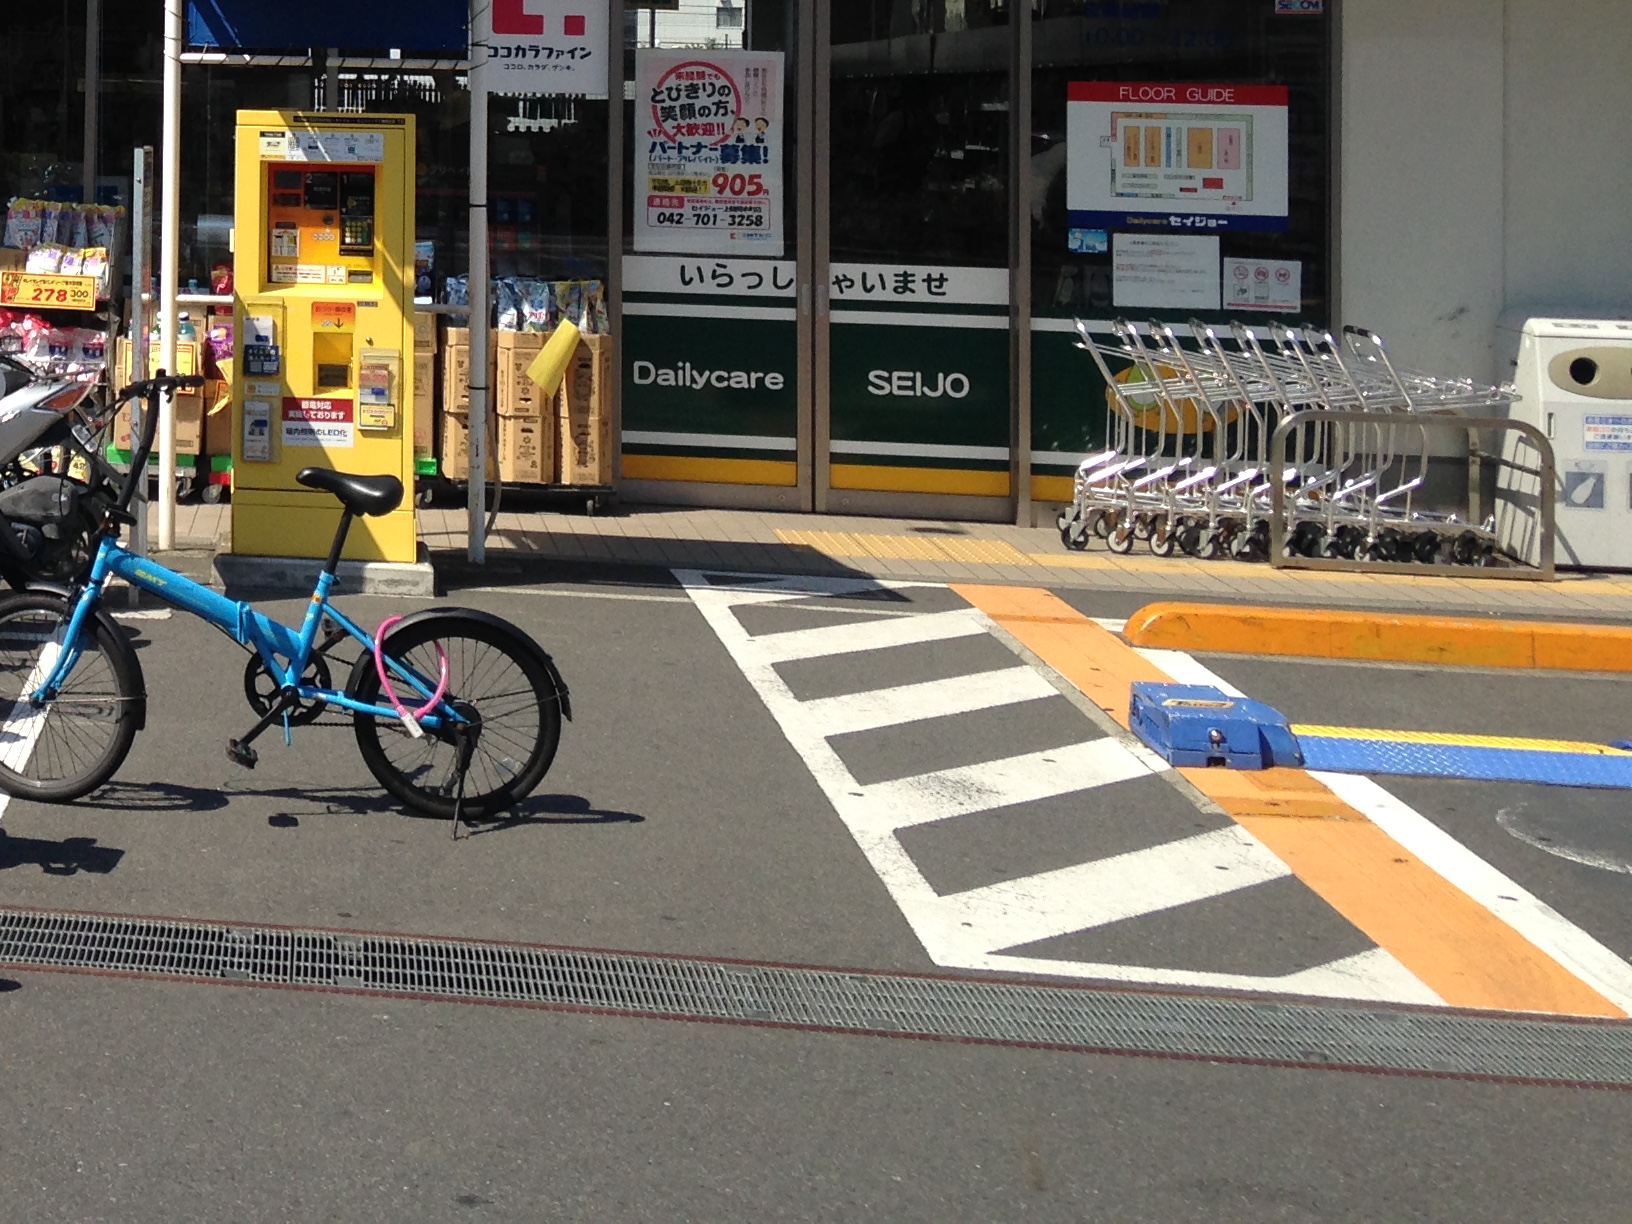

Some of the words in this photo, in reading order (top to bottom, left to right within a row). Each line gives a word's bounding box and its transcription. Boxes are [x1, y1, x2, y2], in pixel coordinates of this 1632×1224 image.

[487, 44, 592, 60] ココカラファイン
[650, 81, 732, 104] とびきりの
[1119, 86, 1176, 101] FLOOR
[1186, 87, 1235, 102] GUIDE
[657, 211, 764, 227] 042-701-3258
[1169, 215, 1228, 227] セイジョー
[679, 263, 949, 297] いらっしゃいませ
[31, 288, 68, 303] 278
[633, 359, 785, 391] Dailycare
[867, 369, 970, 399] SEIJO
